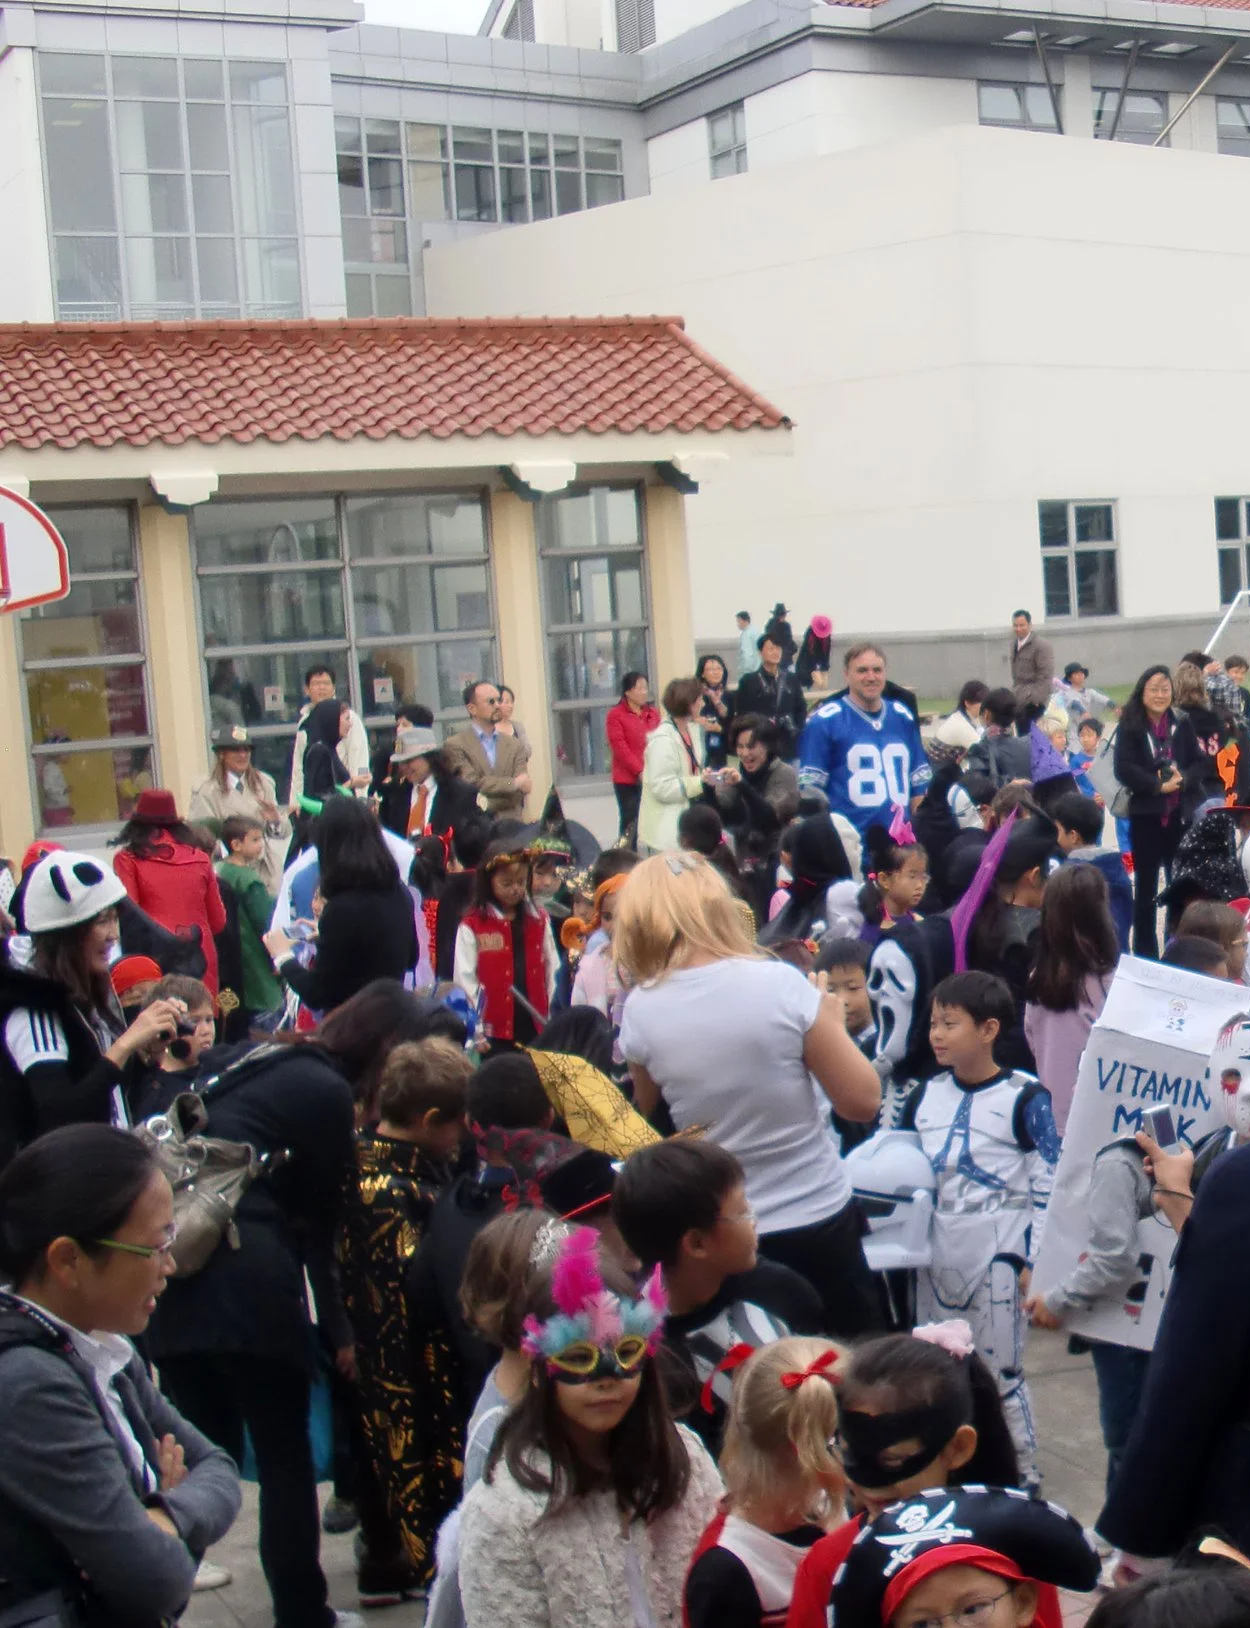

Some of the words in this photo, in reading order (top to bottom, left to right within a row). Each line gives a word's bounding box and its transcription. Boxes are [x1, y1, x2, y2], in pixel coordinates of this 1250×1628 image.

[847, 744, 910, 807] 80
[1097, 1057, 1211, 1112] VITAMIN
[1112, 1103, 1196, 1148] MK
